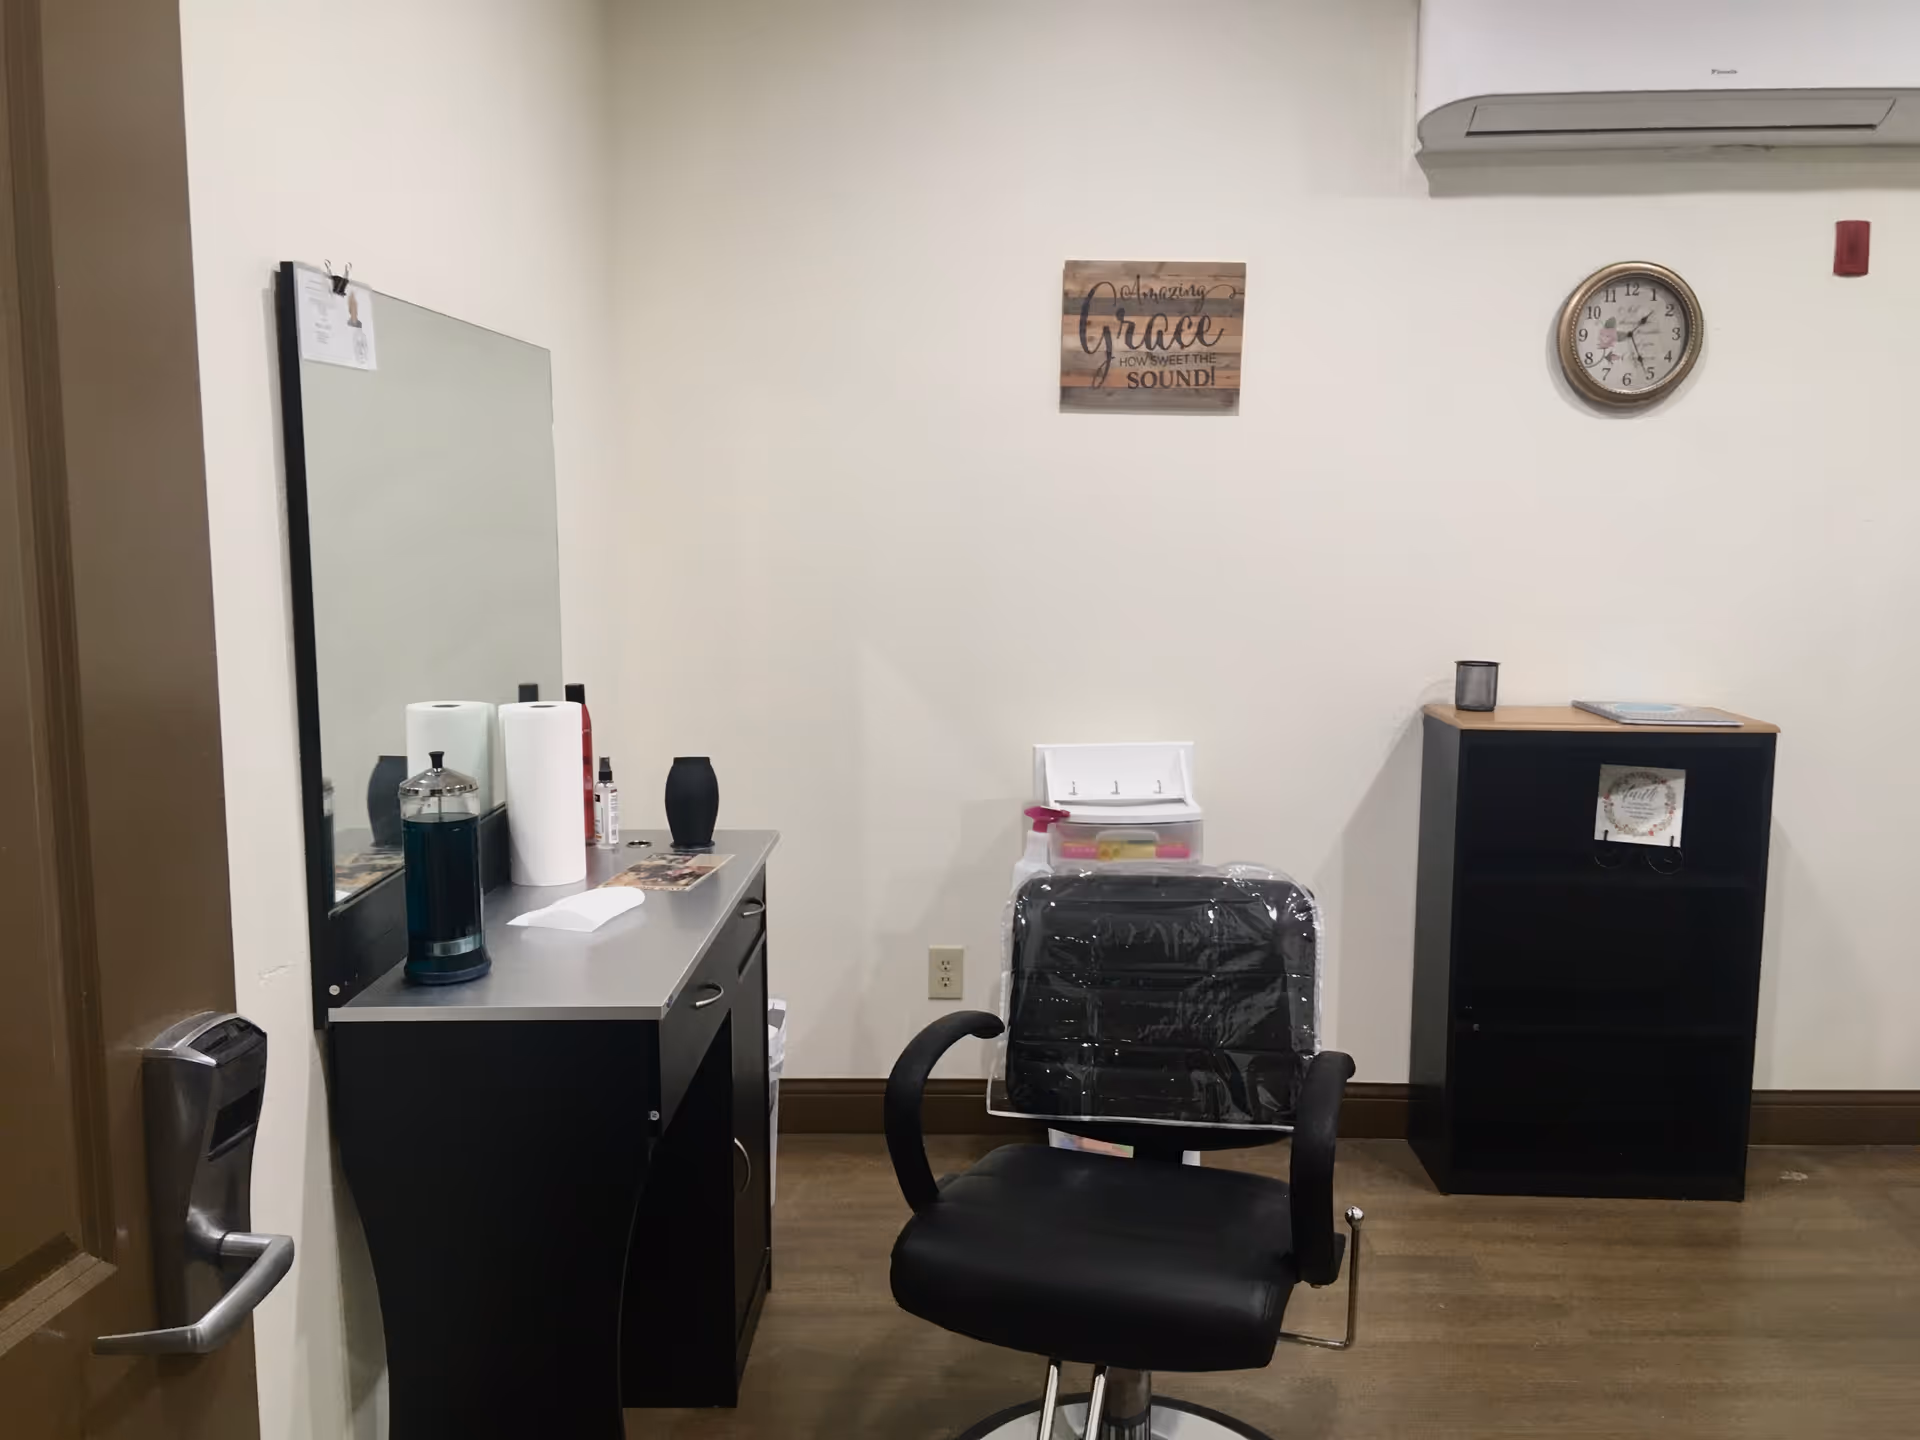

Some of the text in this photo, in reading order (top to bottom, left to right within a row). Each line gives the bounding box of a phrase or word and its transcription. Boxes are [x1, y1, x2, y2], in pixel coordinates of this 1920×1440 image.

[1120, 274, 1236, 314] Amazing
[1604, 289, 1616, 303] 11
[1624, 283, 1640, 296] 12
[1650, 289, 1657, 301] 1
[1587, 306, 1601, 320] 10
[1665, 304, 1674, 317] 2
[1079, 281, 1224, 390] Grace
[1578, 329, 1588, 342] 9
[1672, 328, 1681, 341] 3
[1119, 353, 1216, 367] HOW SWEET THE
[1584, 352, 1594, 365] 8
[1664, 350, 1672, 363] 4
[1127, 366, 1215, 390] SOUND!
[1602, 368, 1611, 381] 7
[1622, 373, 1632, 386] 6
[1646, 367, 1655, 380] 5
